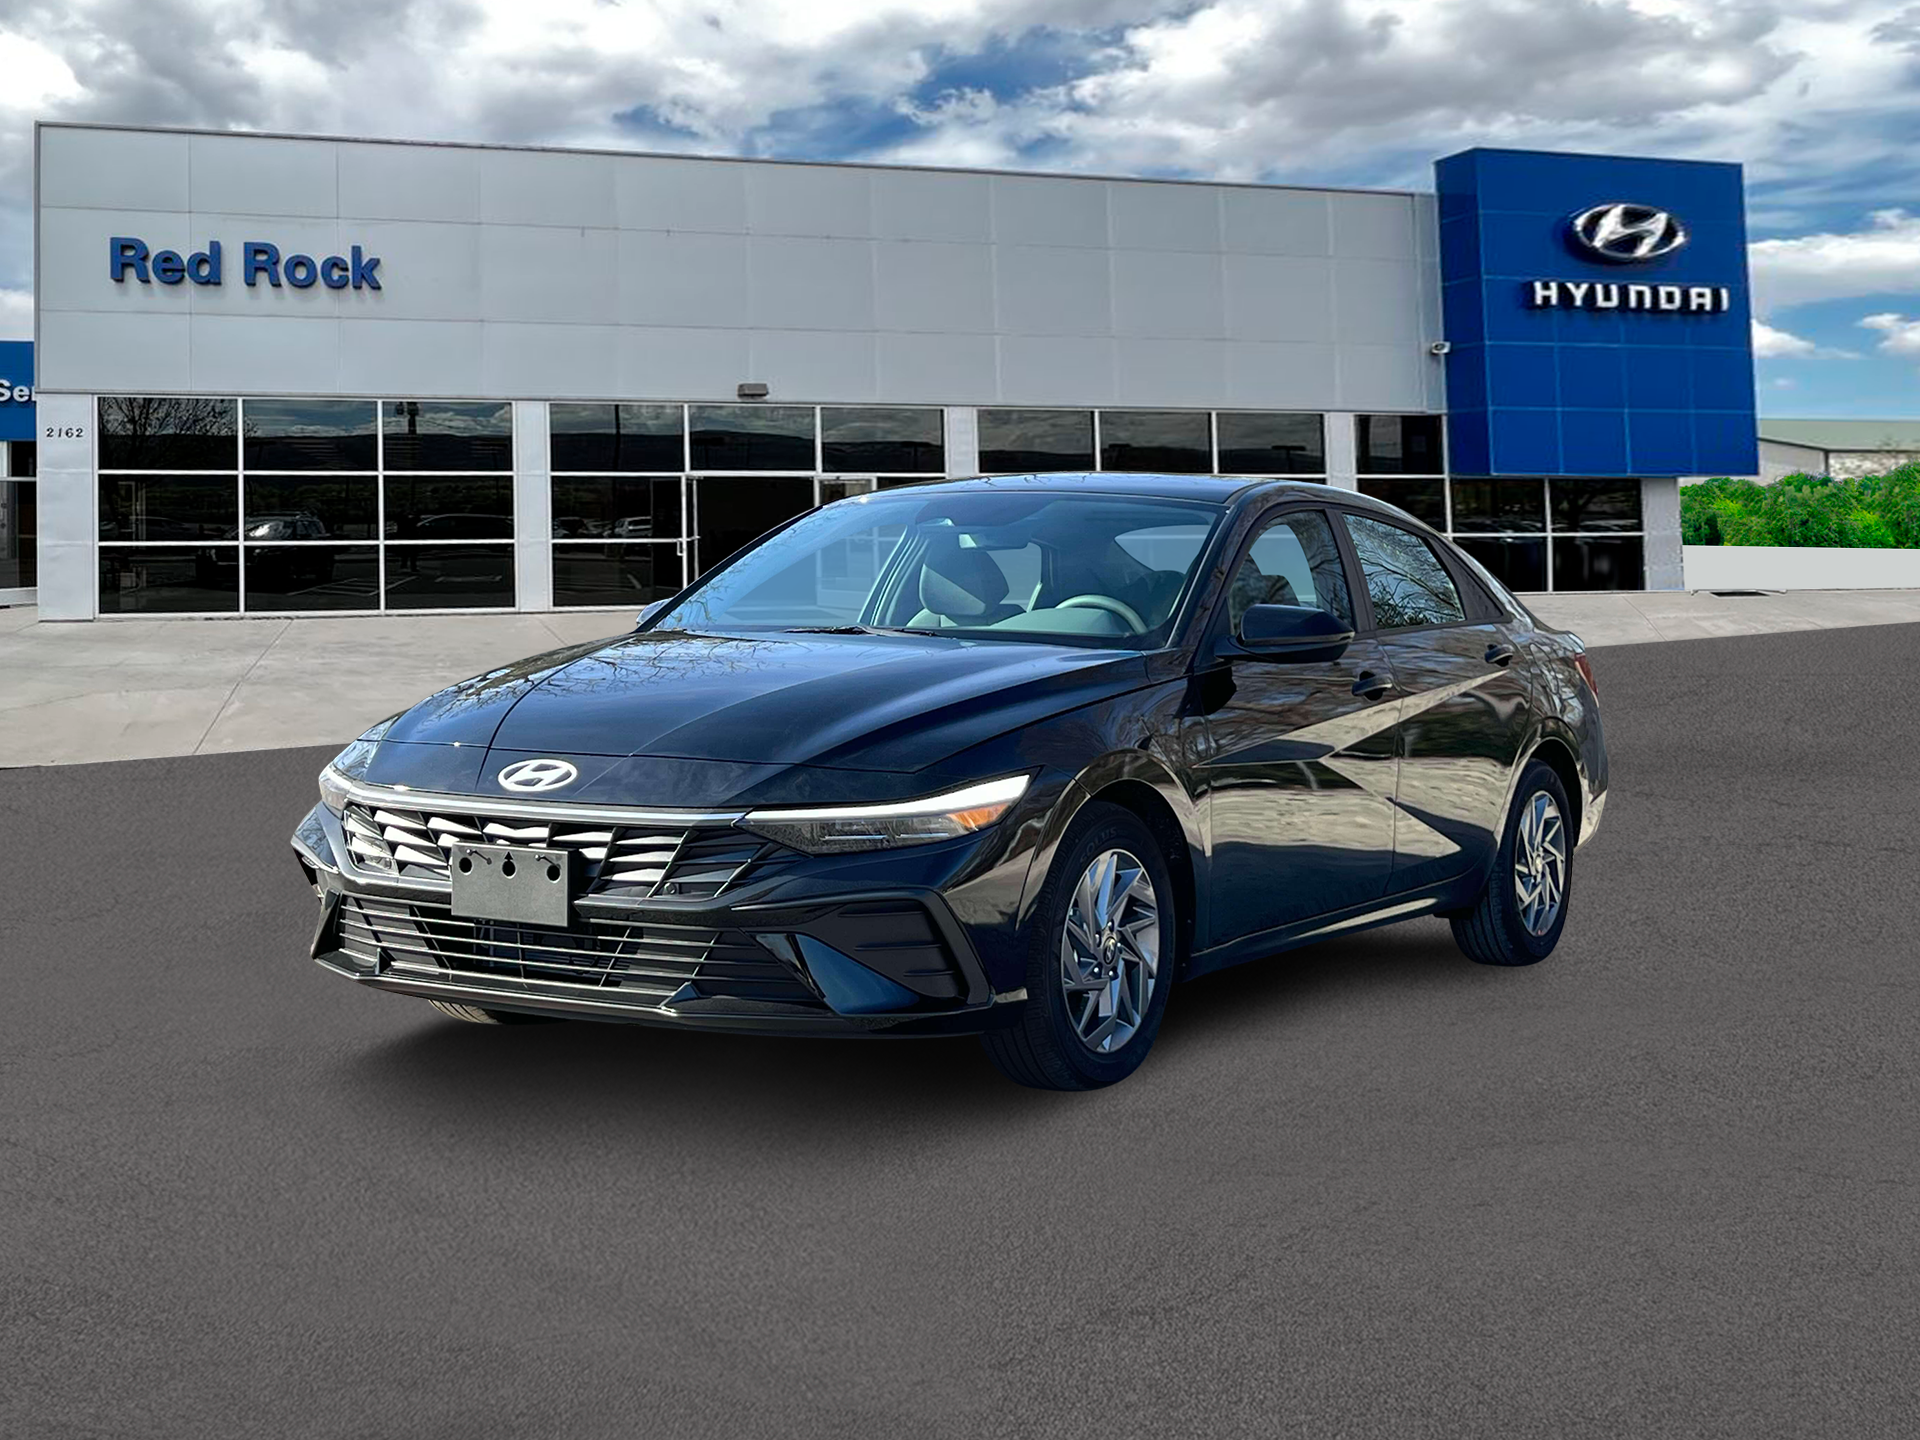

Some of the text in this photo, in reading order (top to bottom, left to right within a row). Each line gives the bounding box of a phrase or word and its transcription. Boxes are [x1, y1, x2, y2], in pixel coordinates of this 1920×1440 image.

[110, 236, 382, 290] Red Rock
[1533, 280, 1730, 312] HYUNDAI
[46, 427, 84, 439] 2162
